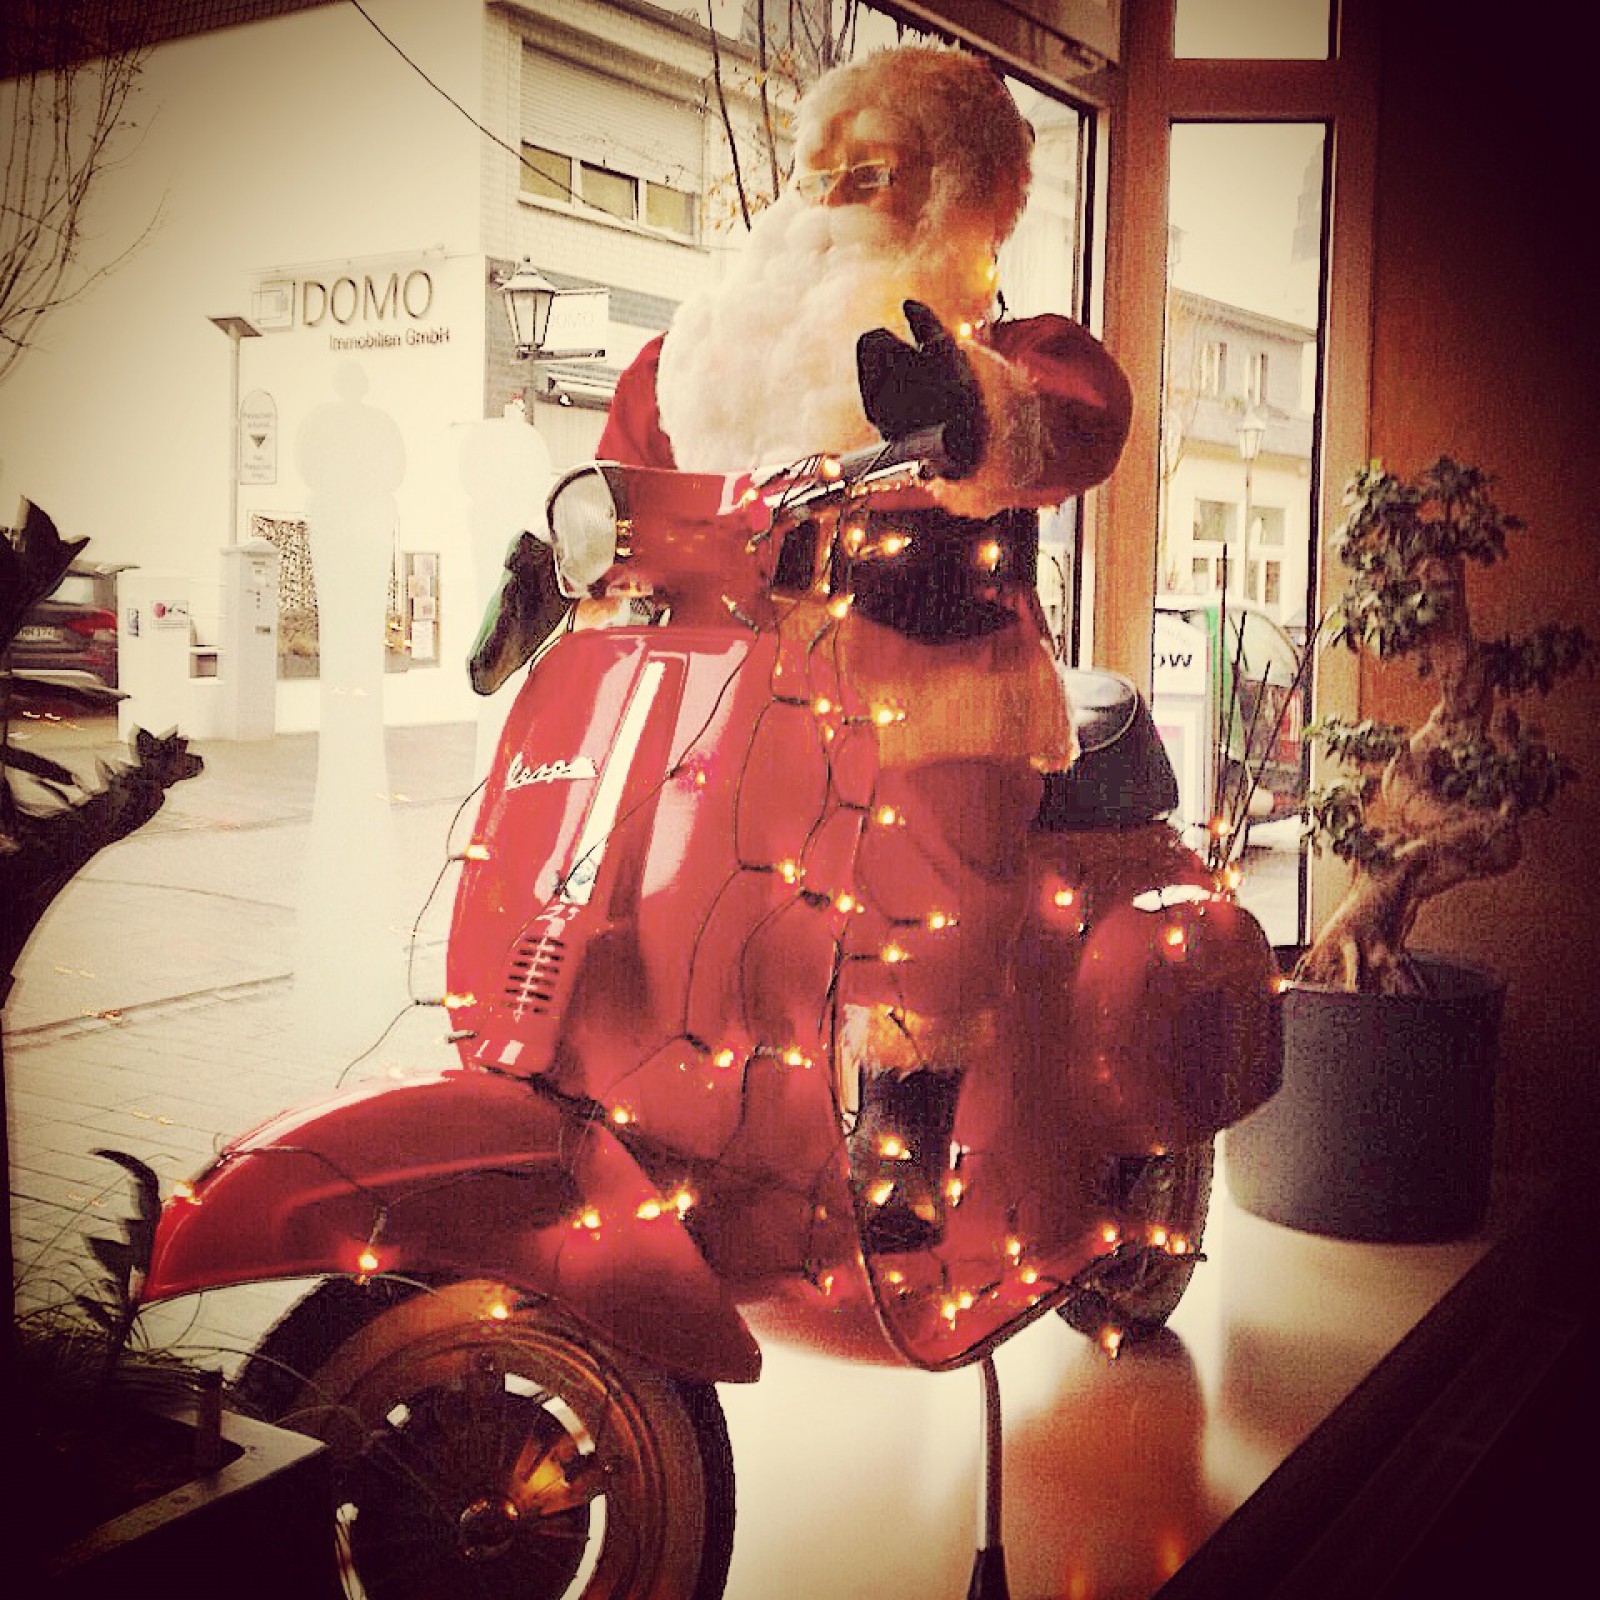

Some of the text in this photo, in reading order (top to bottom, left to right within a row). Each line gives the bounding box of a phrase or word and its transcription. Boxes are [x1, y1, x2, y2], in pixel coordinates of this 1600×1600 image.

[302, 269, 433, 327] DOMO
[329, 326, 450, 352] Immobilien GmbH
[504, 751, 599, 792] Vespa
